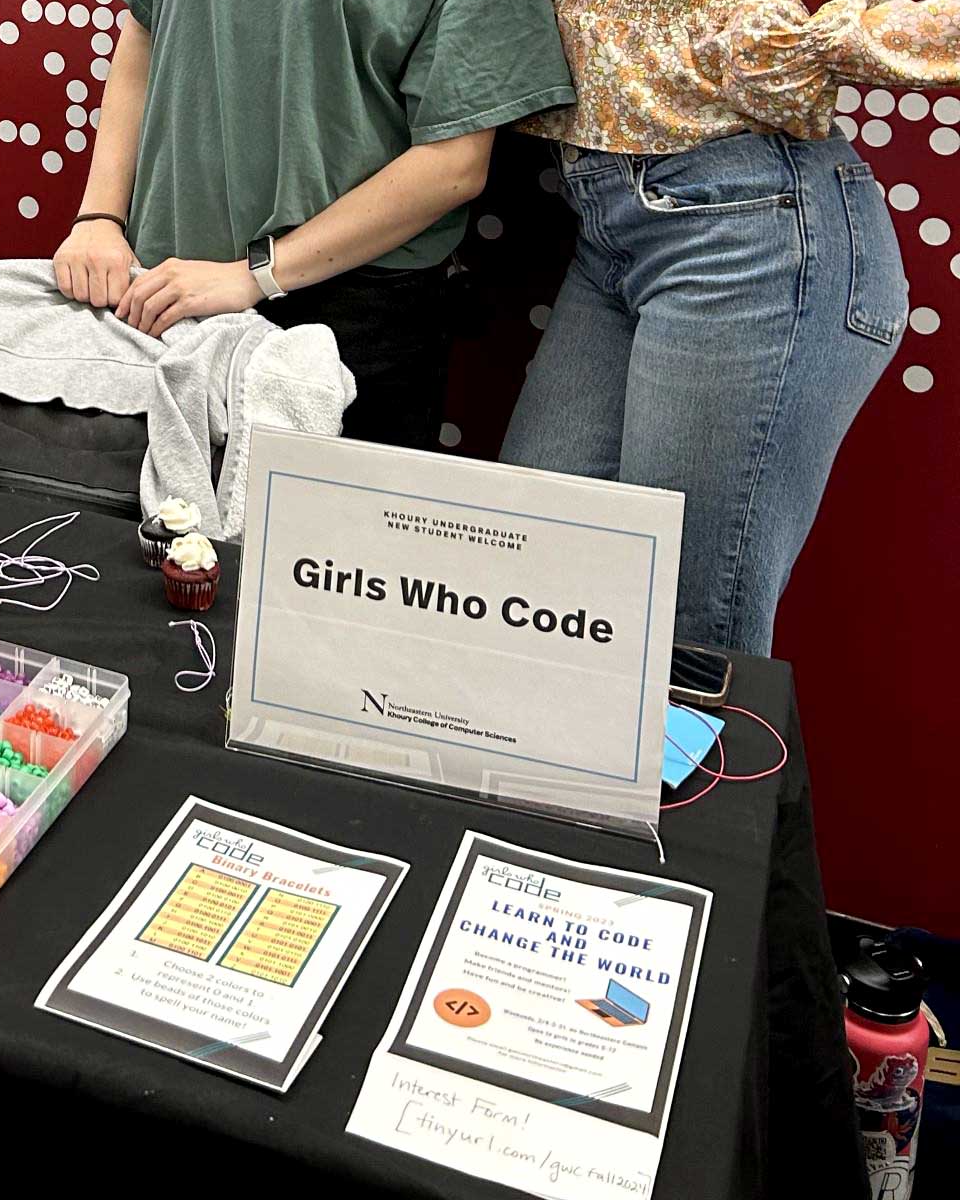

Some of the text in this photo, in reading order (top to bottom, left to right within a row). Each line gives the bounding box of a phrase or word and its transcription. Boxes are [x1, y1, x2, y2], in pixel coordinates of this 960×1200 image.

[383, 510, 528, 542] KHOURY UNDERGRADUATE
[387, 521, 522, 551] NEW STUDENT WELCOME
[293, 557, 614, 644] Girls Who Code
[360, 688, 388, 716] N
[388, 702, 470, 726] Northeastern University
[387, 711, 517, 744] Khoury College of Computer Sciences
[196, 842, 264, 867] code
[211, 854, 332, 897] Binary Bracelets
[488, 877, 562, 903] code
[491, 900, 654, 951] LEARN TO CODE
[546, 931, 588, 951] AND
[459, 919, 671, 985] CHANGE THE WORLD
[391, 1072, 463, 1108] Interest
